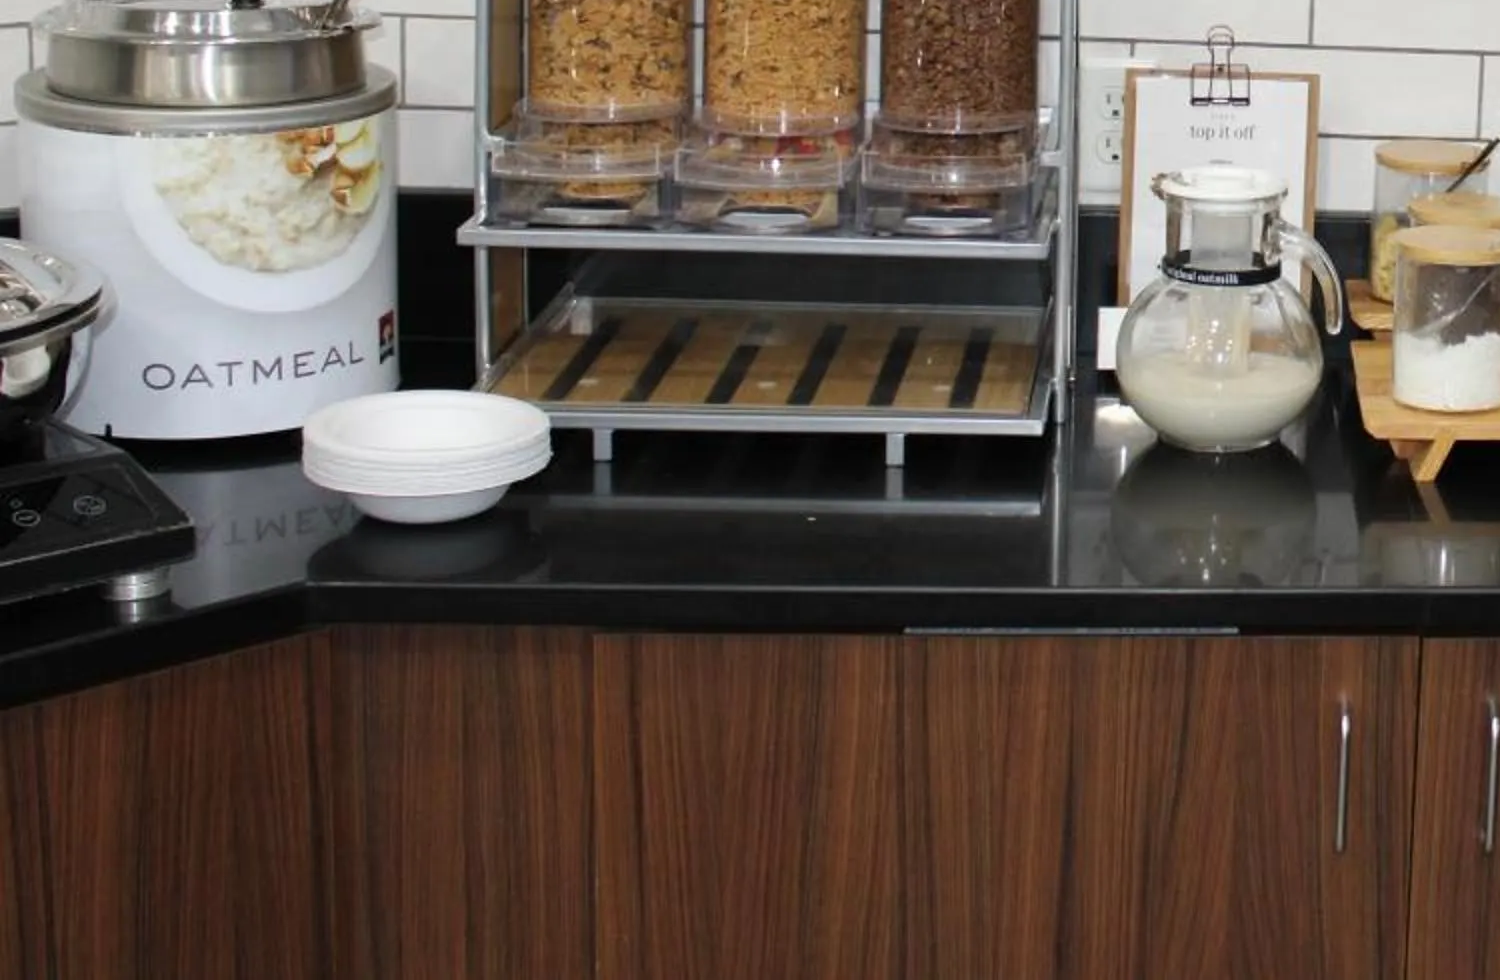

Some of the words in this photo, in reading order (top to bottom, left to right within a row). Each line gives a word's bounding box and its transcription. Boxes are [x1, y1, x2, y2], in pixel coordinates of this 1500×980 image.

[1189, 125, 1215, 141] top
[1218, 124, 1230, 139] it
[1233, 124, 1256, 140] off
[142, 340, 364, 391] OATMEAL
